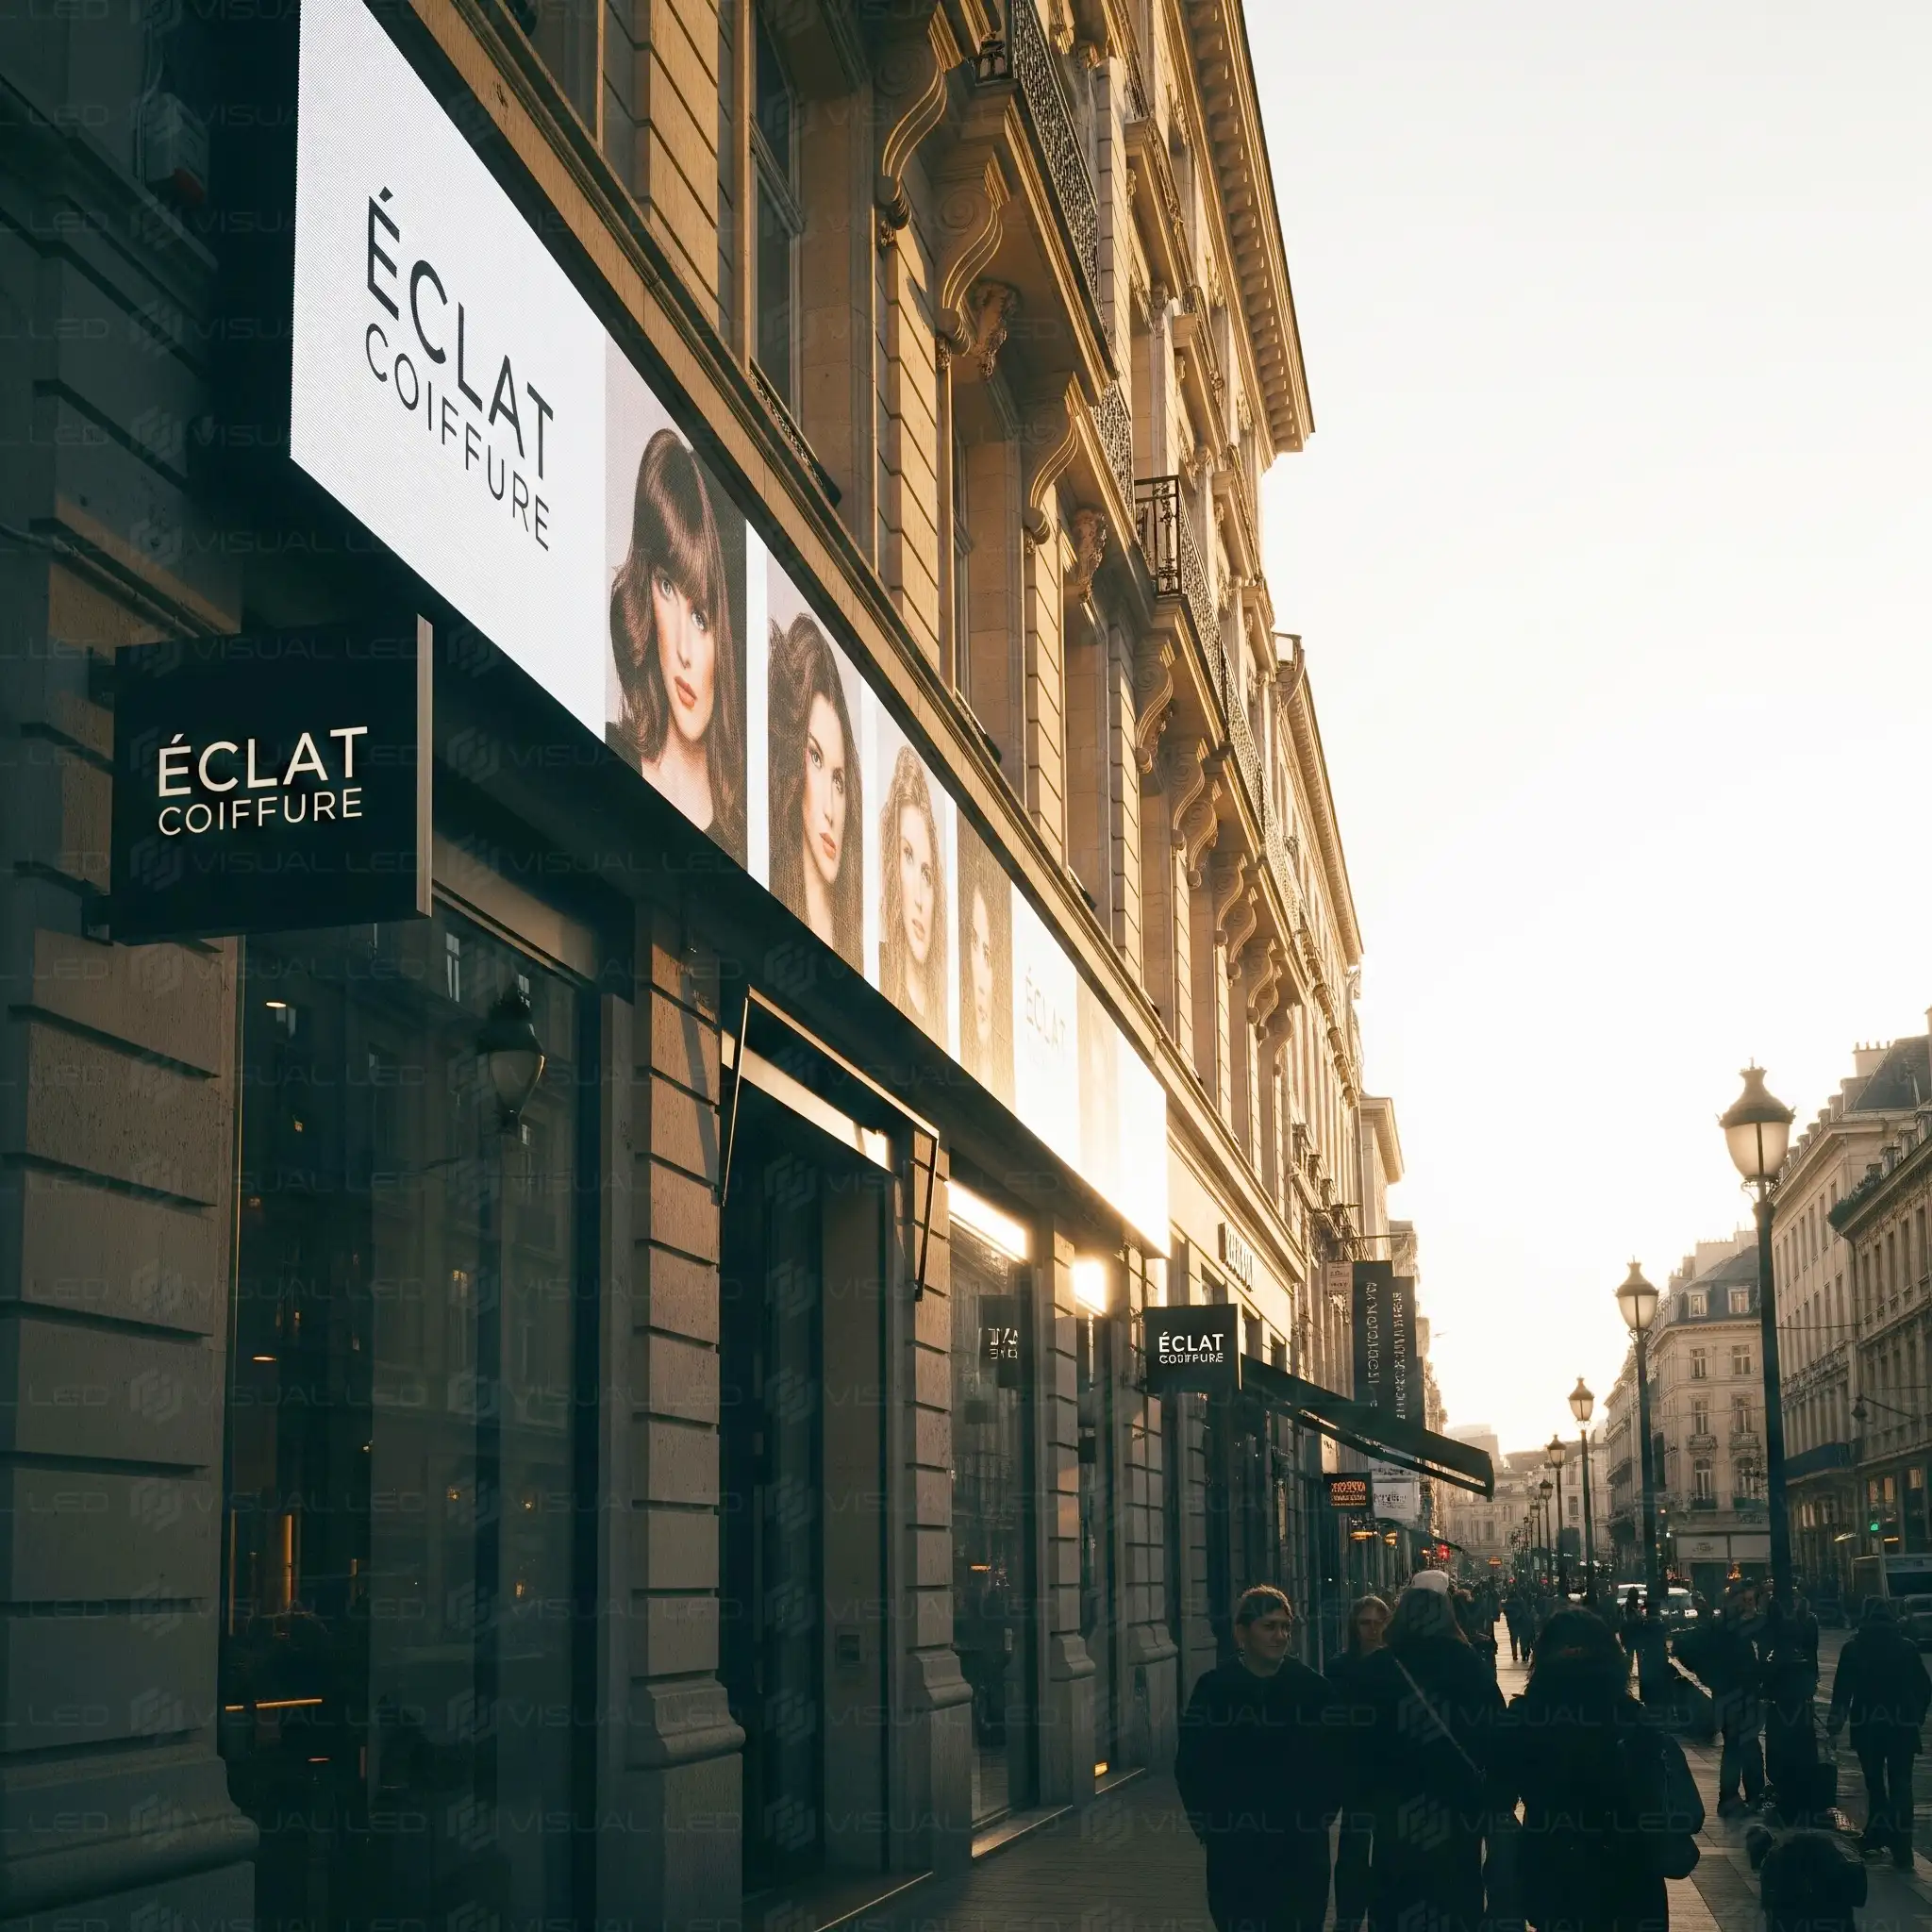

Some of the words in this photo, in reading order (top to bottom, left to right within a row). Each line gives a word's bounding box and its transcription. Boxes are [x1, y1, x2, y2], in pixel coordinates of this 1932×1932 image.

[366, 186, 554, 480] ÉCLAT
[365, 323, 550, 552] COIFFURE
[158, 725, 368, 797] ÉCLAT
[158, 787, 363, 836] COIFFURE
[1158, 1331, 1224, 1353] ÉCLAT
